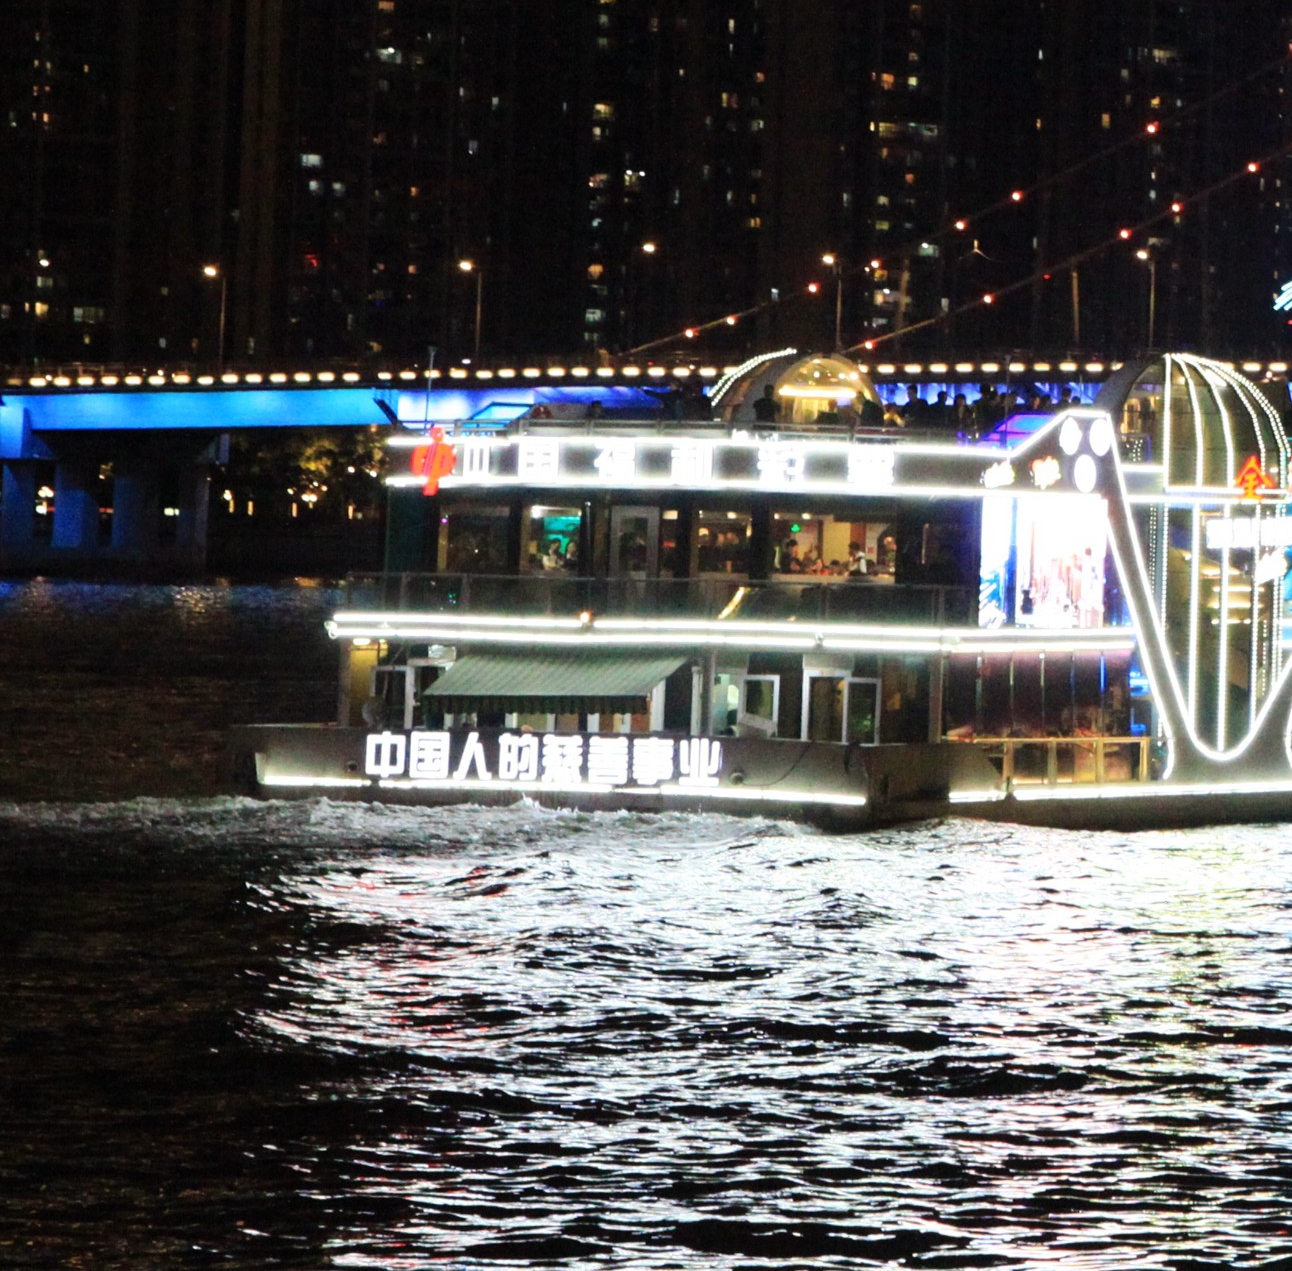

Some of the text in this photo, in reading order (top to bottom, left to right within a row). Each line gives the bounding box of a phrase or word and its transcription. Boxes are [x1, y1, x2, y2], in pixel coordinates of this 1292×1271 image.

[364, 730, 722, 787] 中国人的慈善事业
